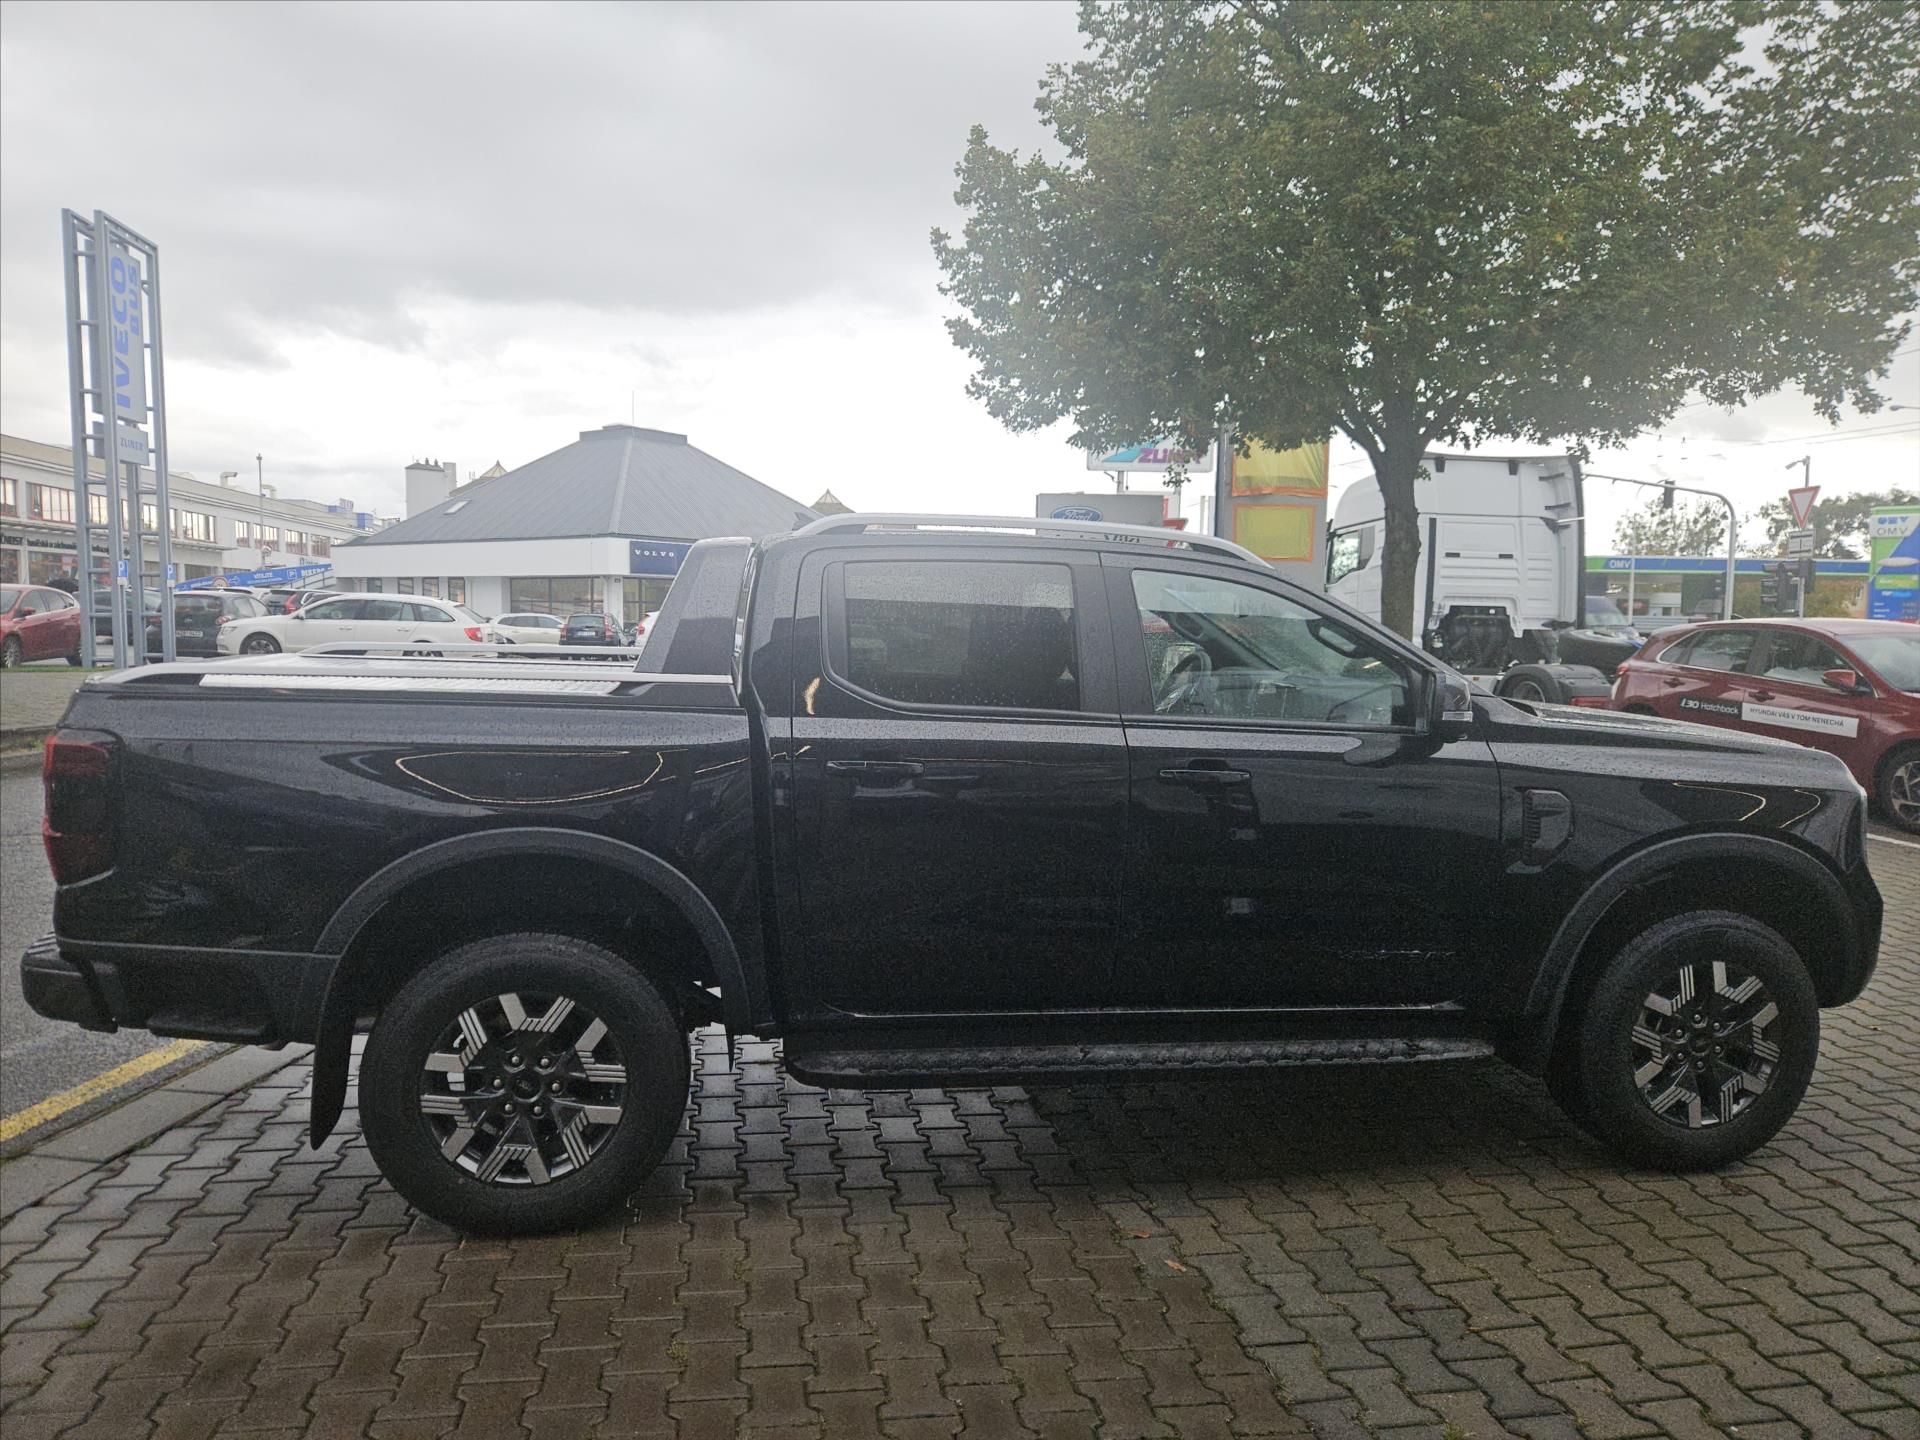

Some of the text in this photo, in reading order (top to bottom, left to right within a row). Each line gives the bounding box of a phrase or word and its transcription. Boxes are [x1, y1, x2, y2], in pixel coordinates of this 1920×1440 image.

[128, 264, 140, 336] BUS
[110, 255, 131, 409] IVECO
[1876, 527, 1908, 536] OMV
[634, 549, 675, 558] VOLVO
[1609, 559, 1630, 569] OMV
[1700, 701, 1739, 715] Hatchback
[1750, 707, 1777, 718] HYUNDAI
[1797, 714, 1812, 723] TOM
